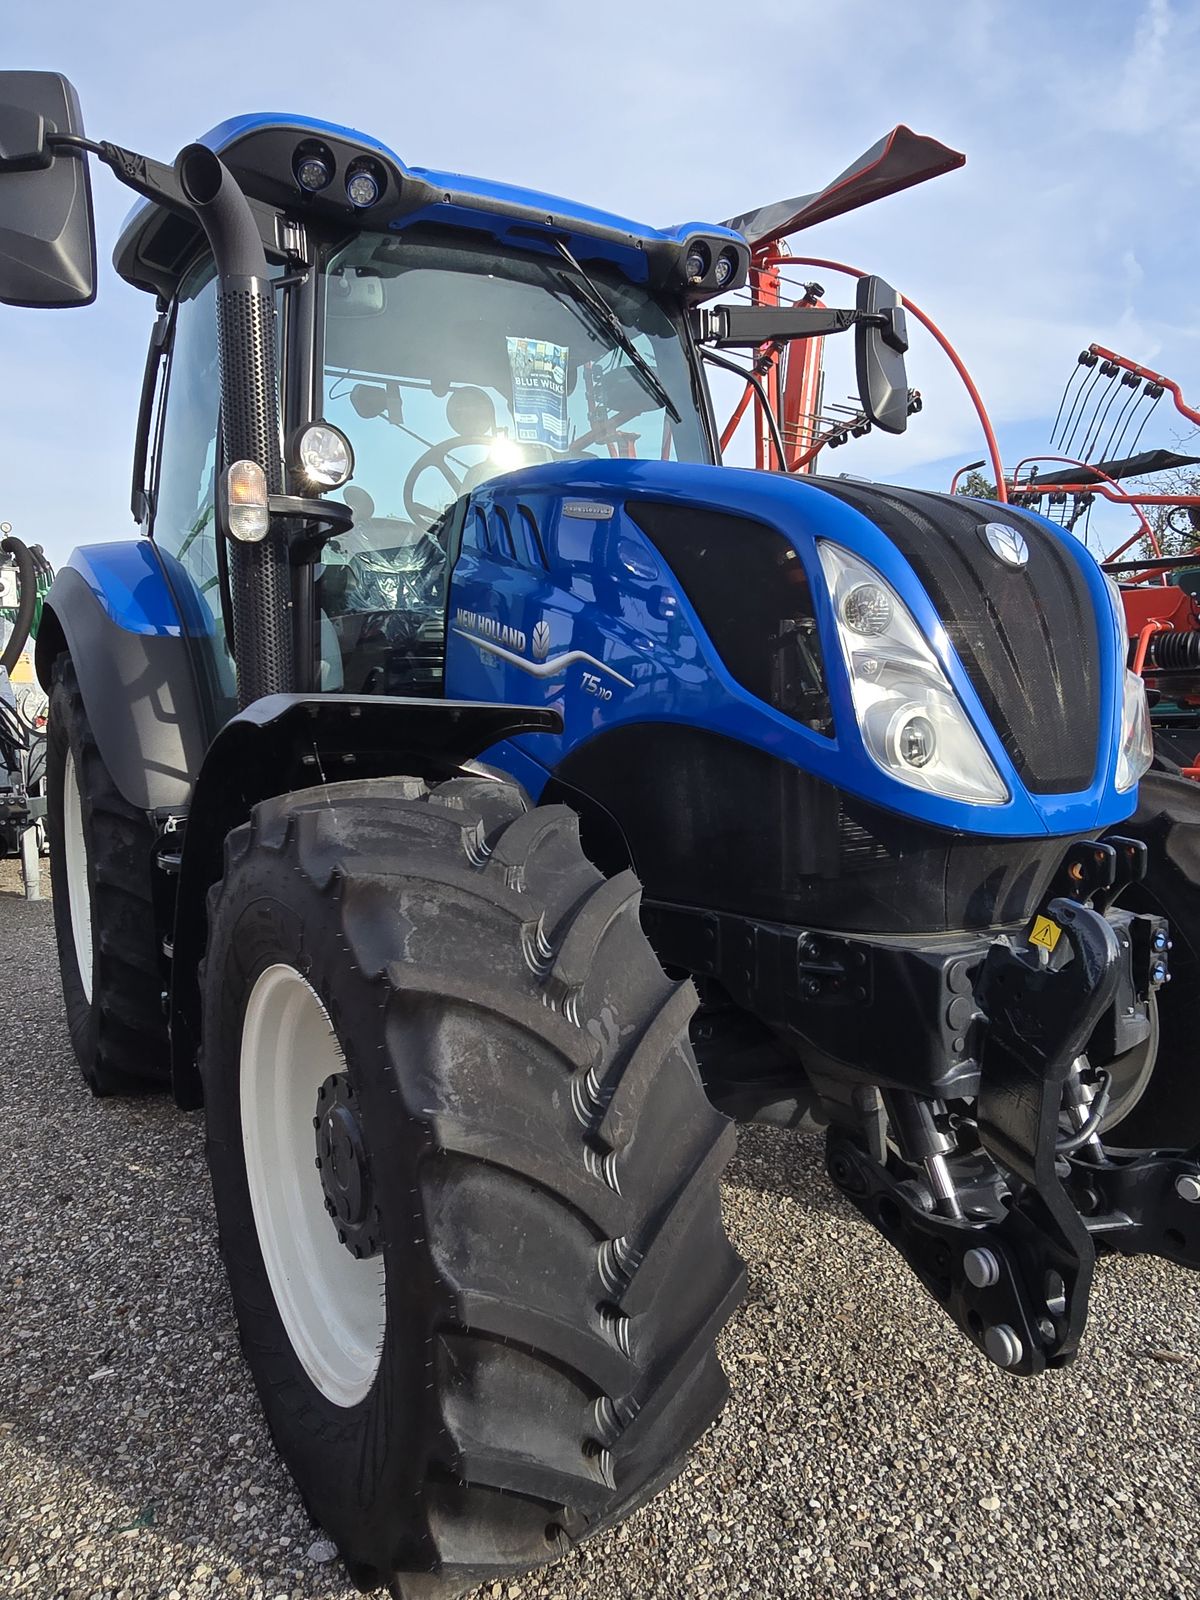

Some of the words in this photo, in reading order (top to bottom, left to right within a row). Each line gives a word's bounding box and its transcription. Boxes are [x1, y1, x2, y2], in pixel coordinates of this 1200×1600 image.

[515, 377, 539, 387] BLUE
[457, 607, 477, 629] NEW
[478, 614, 526, 653] HOLLAND
